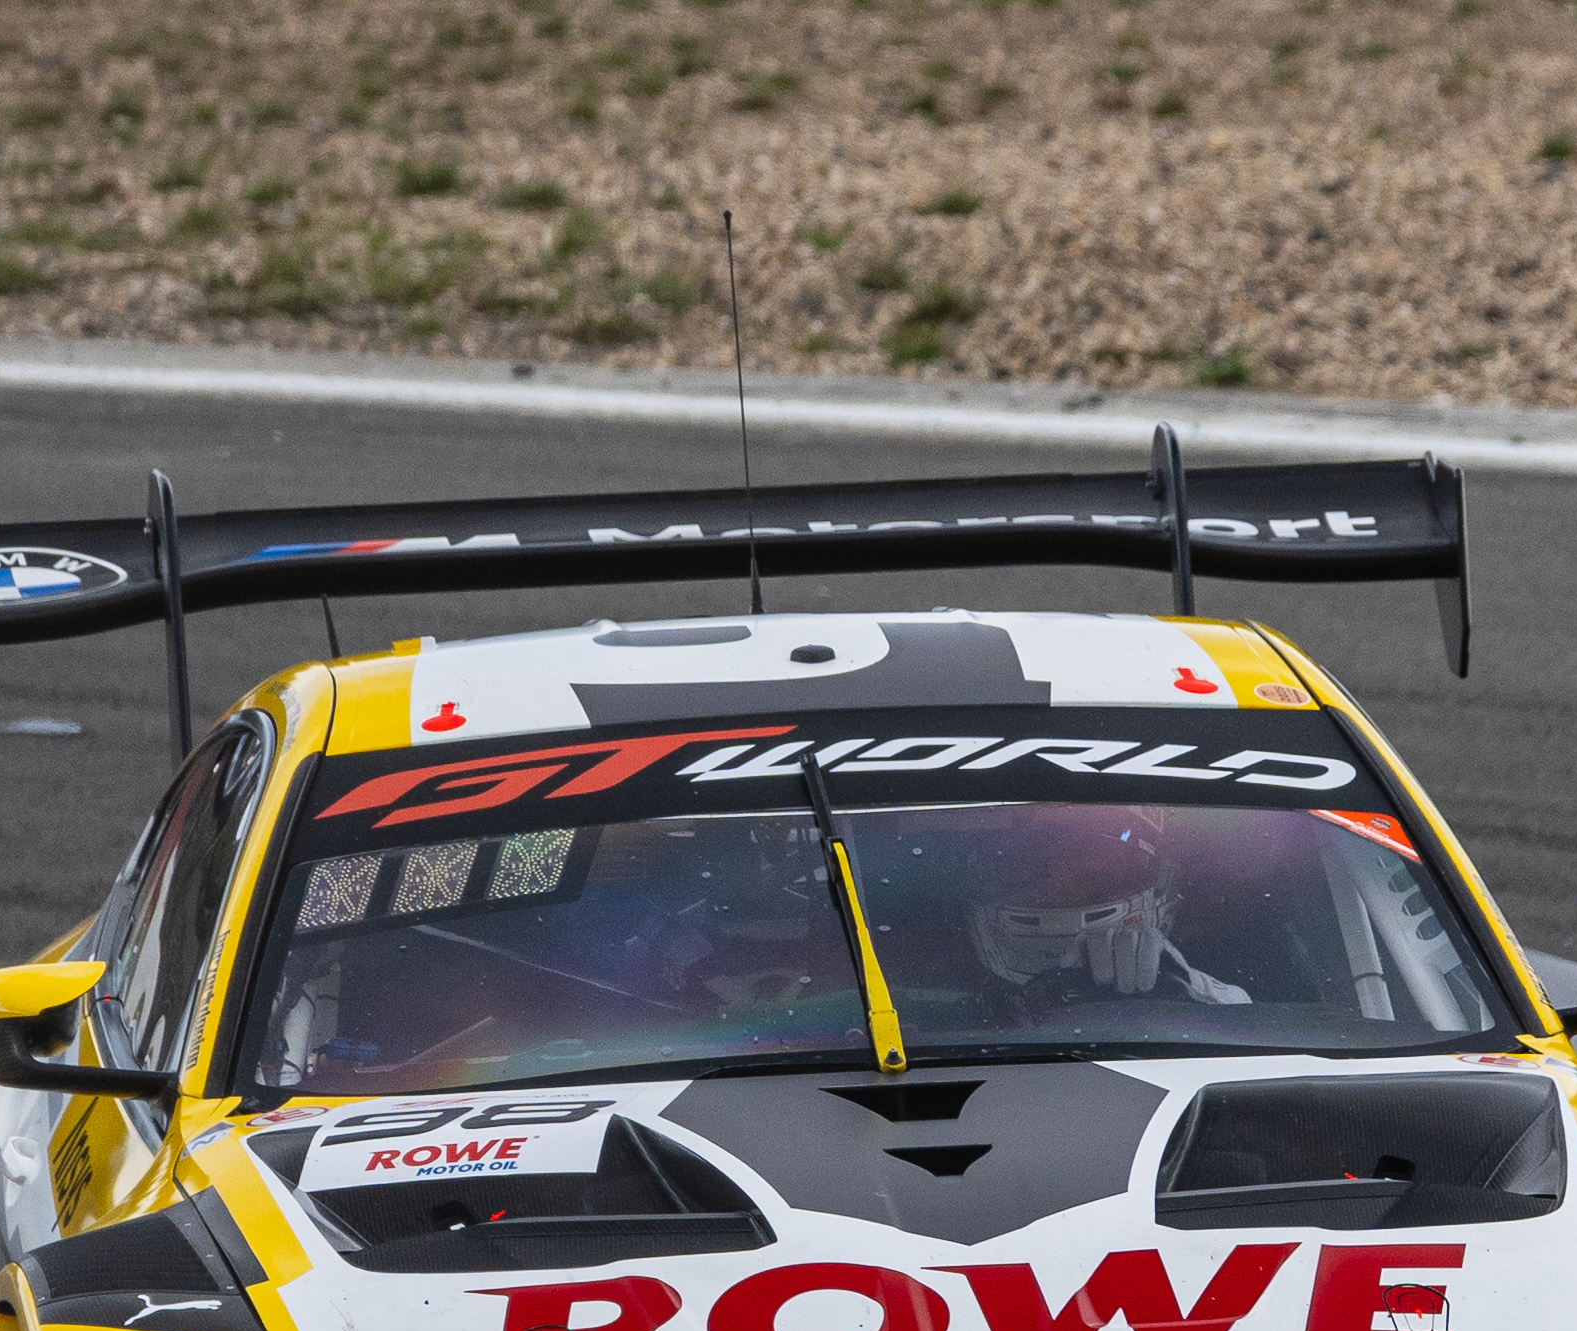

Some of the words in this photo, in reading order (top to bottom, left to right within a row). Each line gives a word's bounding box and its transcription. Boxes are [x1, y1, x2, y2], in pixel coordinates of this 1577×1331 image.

[314, 725, 799, 829] GT
[676, 737, 1357, 790] WORLD
[320, 1100, 617, 1147] 98
[365, 1137, 528, 1172] ROWE
[416, 1161, 484, 1176] MOTOR
[489, 1160, 518, 1170] OIL
